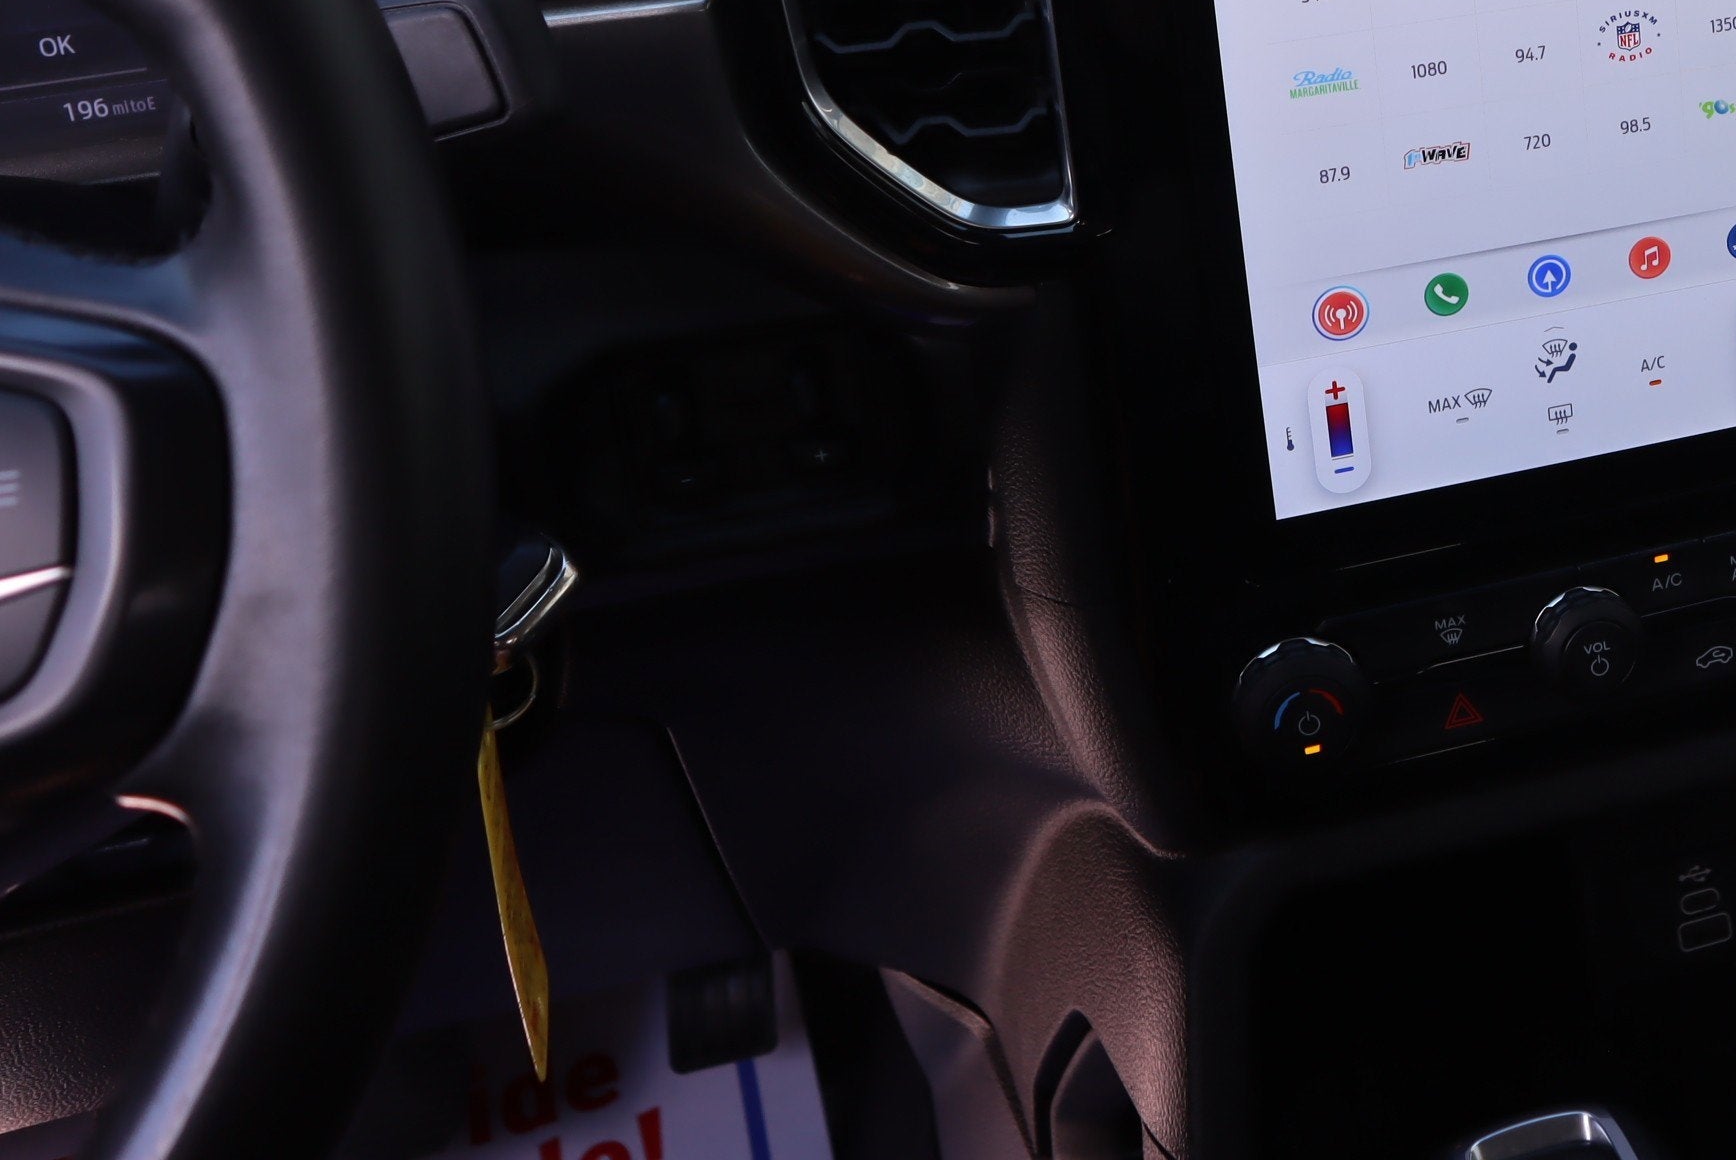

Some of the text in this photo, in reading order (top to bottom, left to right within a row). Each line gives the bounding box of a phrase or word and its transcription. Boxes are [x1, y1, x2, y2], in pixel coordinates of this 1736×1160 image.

[38, 34, 76, 57] OK
[1619, 33, 1639, 48] NFL
[1515, 45, 1546, 64] 94.7
[1608, 47, 1653, 62] RADIO
[1411, 60, 1448, 79] 1080
[63, 98, 109, 122] 196
[1620, 116, 1651, 135] 98.5
[1523, 133, 1551, 152] 720
[1319, 165, 1351, 184] 87.9
[1640, 355, 1666, 373] A/C
[1428, 396, 1462, 415] MAX
[1652, 572, 1683, 591] A/C
[1434, 614, 1466, 631] MAX
[1583, 640, 1611, 655] VOL
[467, 1052, 619, 1144] ide
